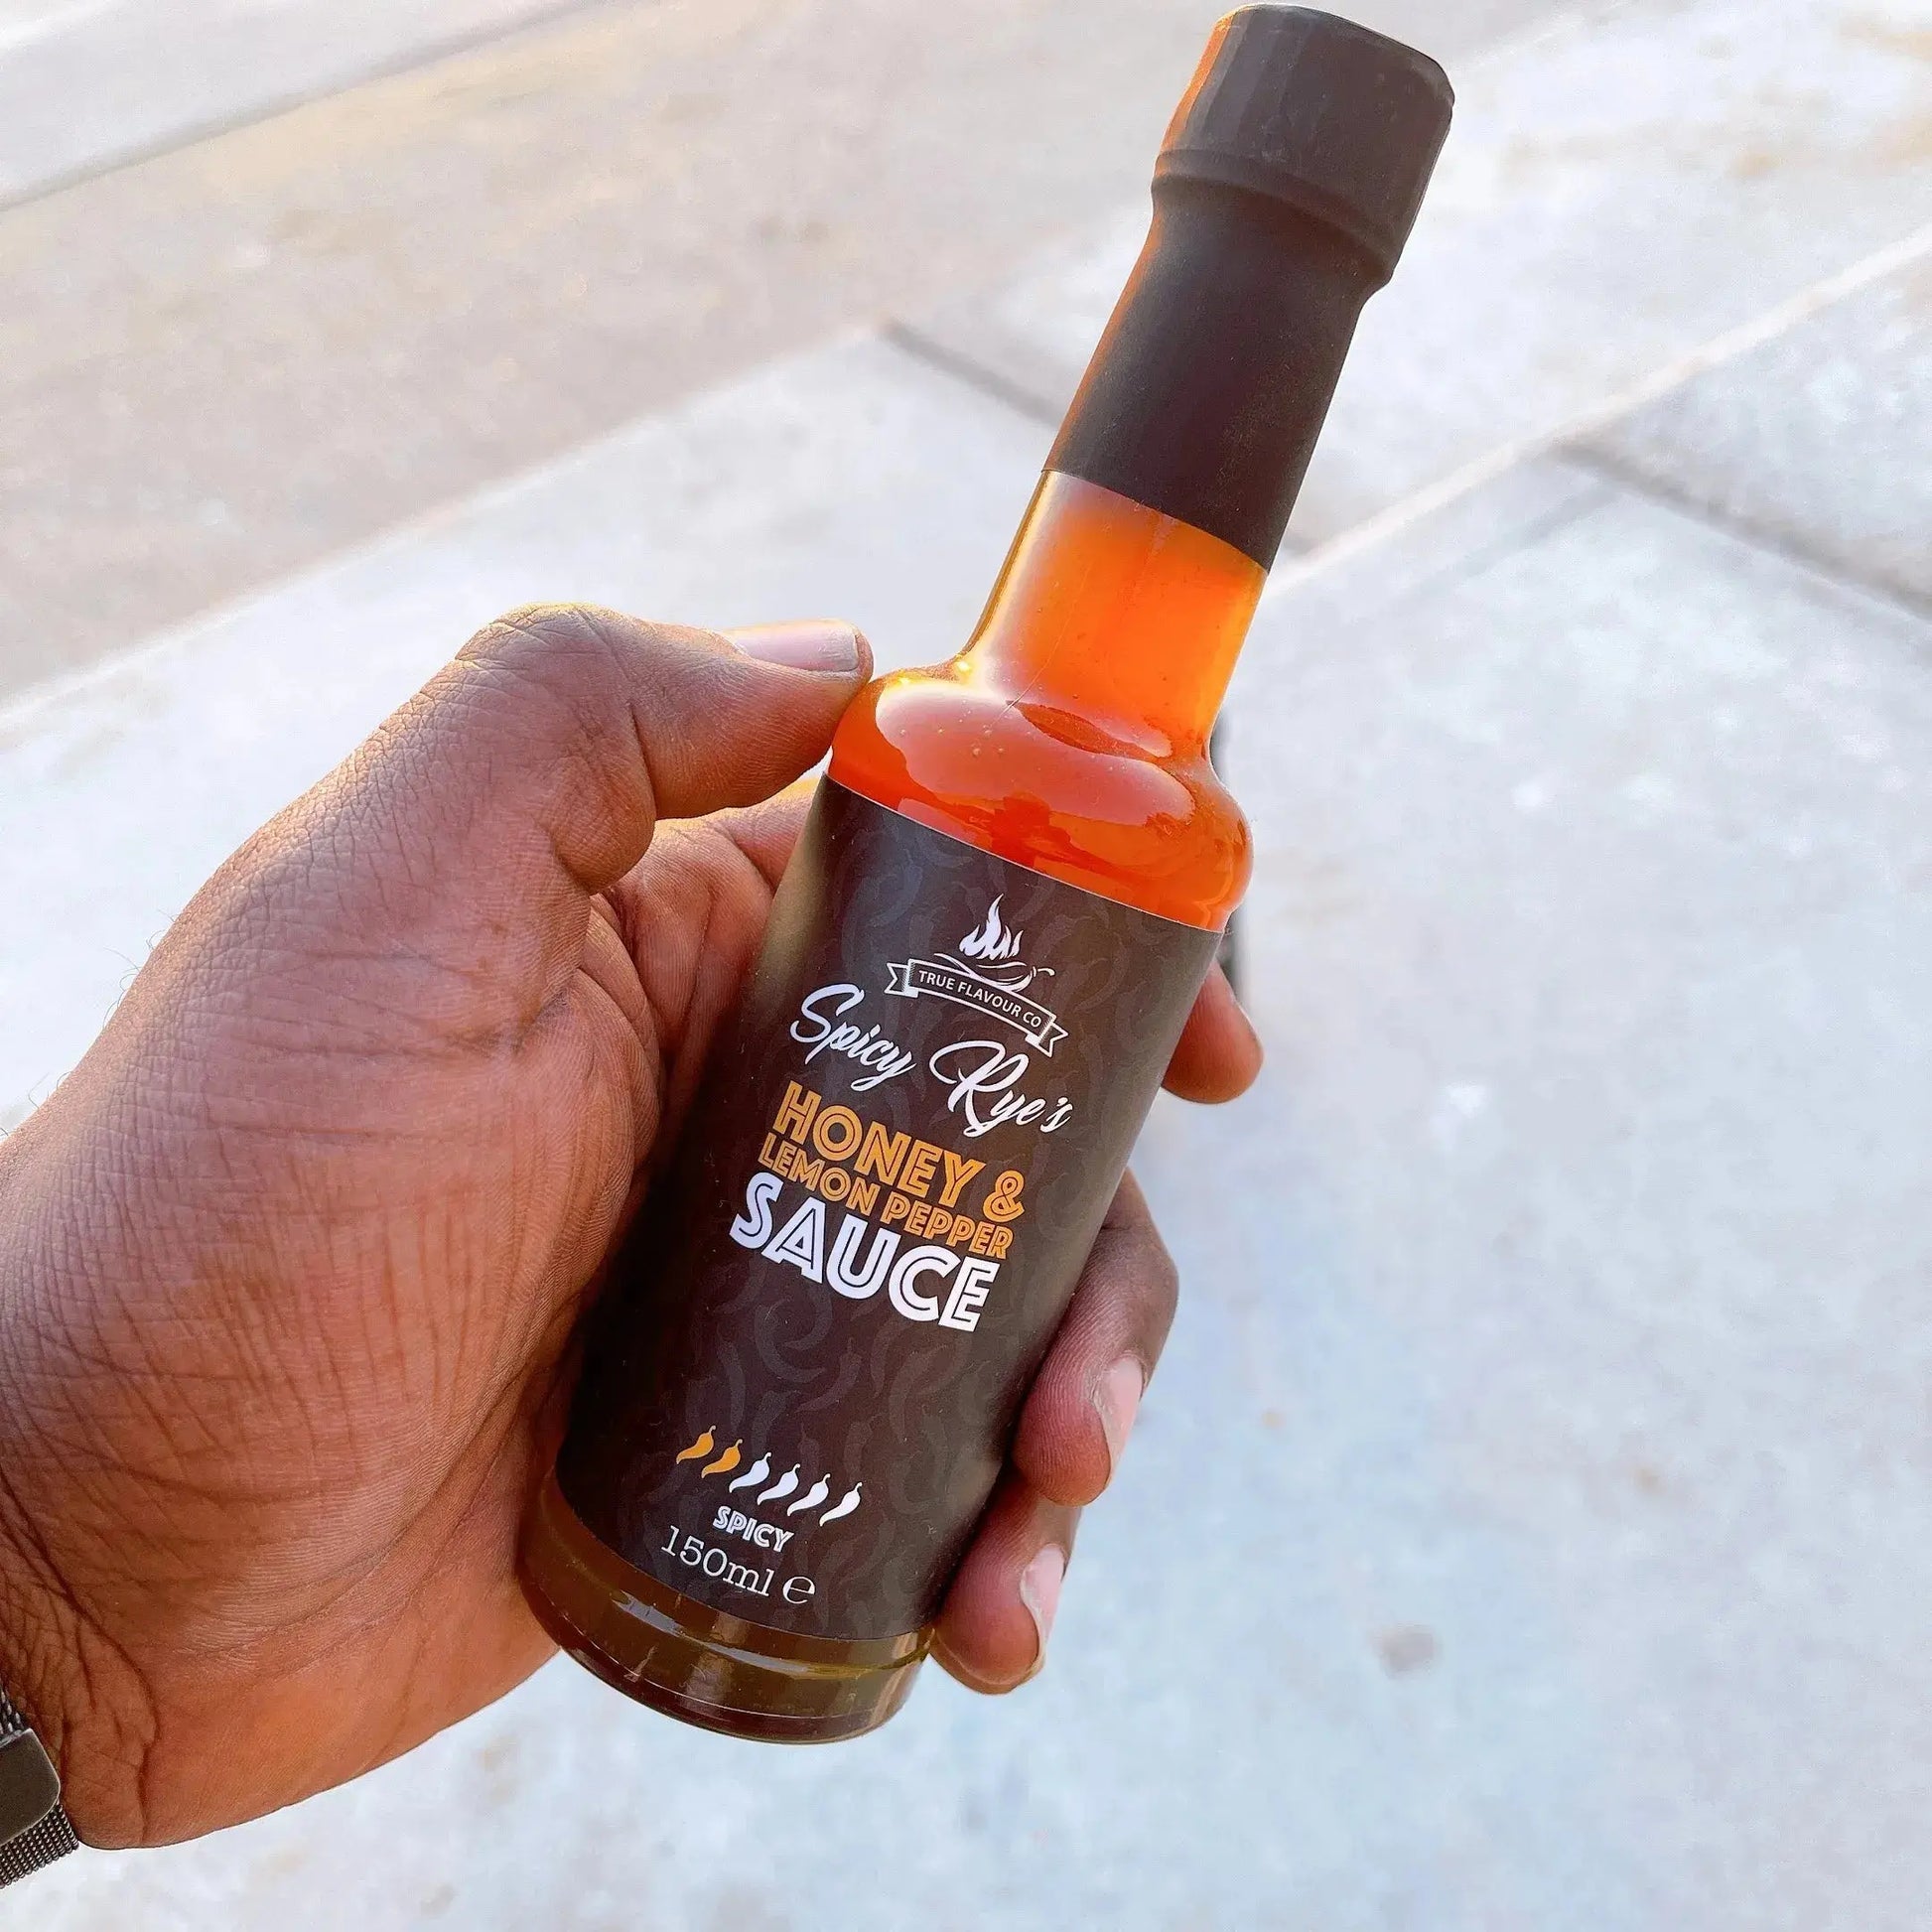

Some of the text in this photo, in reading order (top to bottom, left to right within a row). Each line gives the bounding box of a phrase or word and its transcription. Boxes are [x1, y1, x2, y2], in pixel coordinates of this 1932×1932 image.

[789, 984, 1073, 1138] Spicy Rye's
[918, 969, 1041, 1029] TRUE FLAVOUR CO
[759, 1133, 1015, 1260] LEMON PEPPER
[773, 1080, 1026, 1222] HONEY &
[729, 1171, 1001, 1332] SAUCE
[660, 1525, 775, 1597] 150ml
[712, 1505, 794, 1553] SPICY
